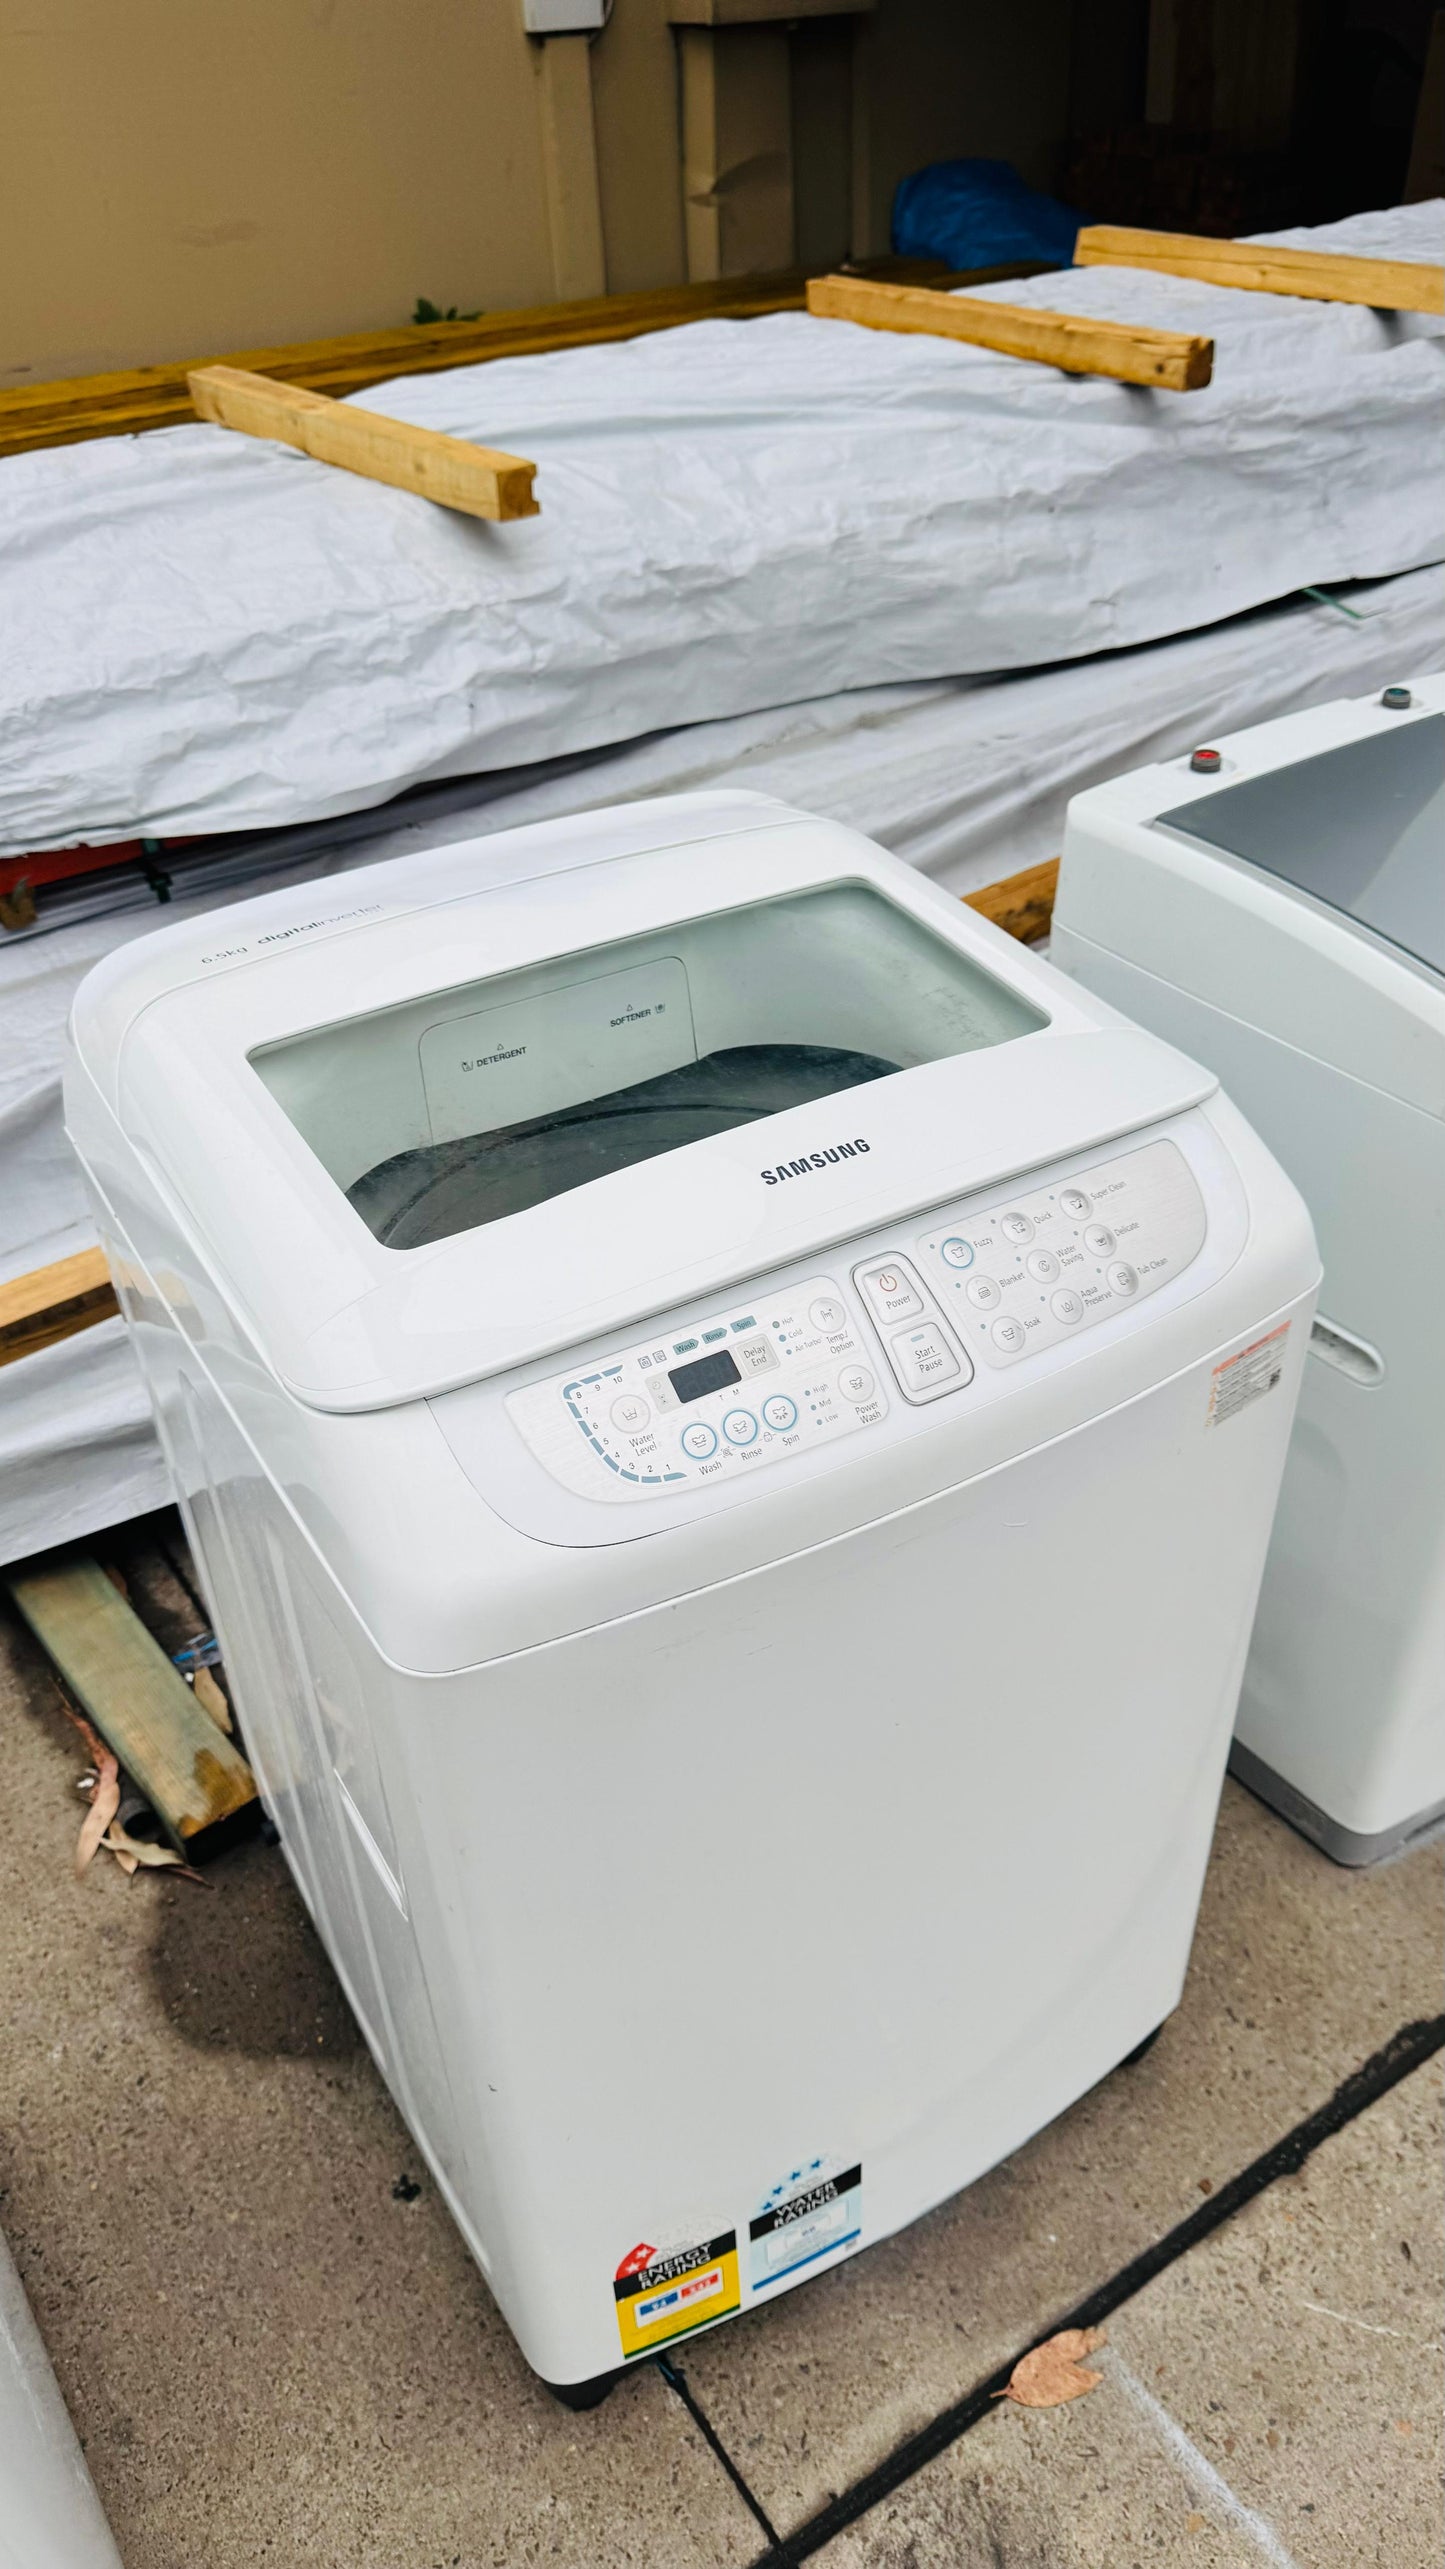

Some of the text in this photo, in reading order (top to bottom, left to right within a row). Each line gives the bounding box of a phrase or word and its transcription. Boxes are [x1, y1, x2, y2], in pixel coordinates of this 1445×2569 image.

[202, 946, 249, 964] 6.5kg
[610, 1008, 652, 1028] SOFTENER
[476, 1046, 528, 1068] DETERGENT
[760, 1138, 871, 1185] SAMSUNG
[1090, 1181, 1128, 1200] Super Clean
[1033, 1211, 1053, 1224] Quick
[1113, 1221, 1141, 1237] Delicate
[973, 1237, 994, 1249] Fuzzy
[1055, 1244, 1077, 1258] Water
[1061, 1253, 1085, 1267] Saving
[1137, 1257, 1169, 1275] Tub Clean
[998, 1272, 1026, 1288] Blanket
[1080, 1285, 1099, 1298] Aqua
[885, 1295, 911, 1310] Power
[1084, 1290, 1113, 1308] Preserve
[736, 1319, 752, 1331] Spin
[1024, 1316, 1042, 1330] Soak
[705, 1330, 724, 1342] Rinse
[788, 1328, 803, 1340] Cold
[676, 1340, 696, 1353] Wash
[743, 1344, 767, 1360] Delay
[830, 1340, 855, 1355] Option
[914, 1345, 936, 1360] Start
[751, 1355, 768, 1368] End
[919, 1358, 943, 1373] Pause
[613, 1375, 623, 1385] 10
[576, 1391, 582, 1399] 8
[594, 1384, 601, 1392] 9
[813, 1383, 829, 1394] High
[819, 1397, 832, 1408] Mid
[855, 1401, 879, 1416] Power
[824, 1413, 839, 1424] Low
[860, 1410, 882, 1425] Wash
[592, 1422, 599, 1430] 6
[603, 1437, 609, 1446] 5
[628, 1433, 655, 1448] Water
[782, 1433, 801, 1447] Spin
[614, 1451, 621, 1459] 4
[635, 1441, 658, 1457] Level
[740, 1447, 763, 1461] Rinse
[628, 1462, 636, 1470] 3
[647, 1464, 654, 1473] 2
[698, 1460, 723, 1476] Wash
[776, 2180, 837, 2217] WATER
[774, 2188, 839, 2230] RATING
[638, 2241, 712, 2282] ENERGY
[641, 2253, 712, 2291] RATING
